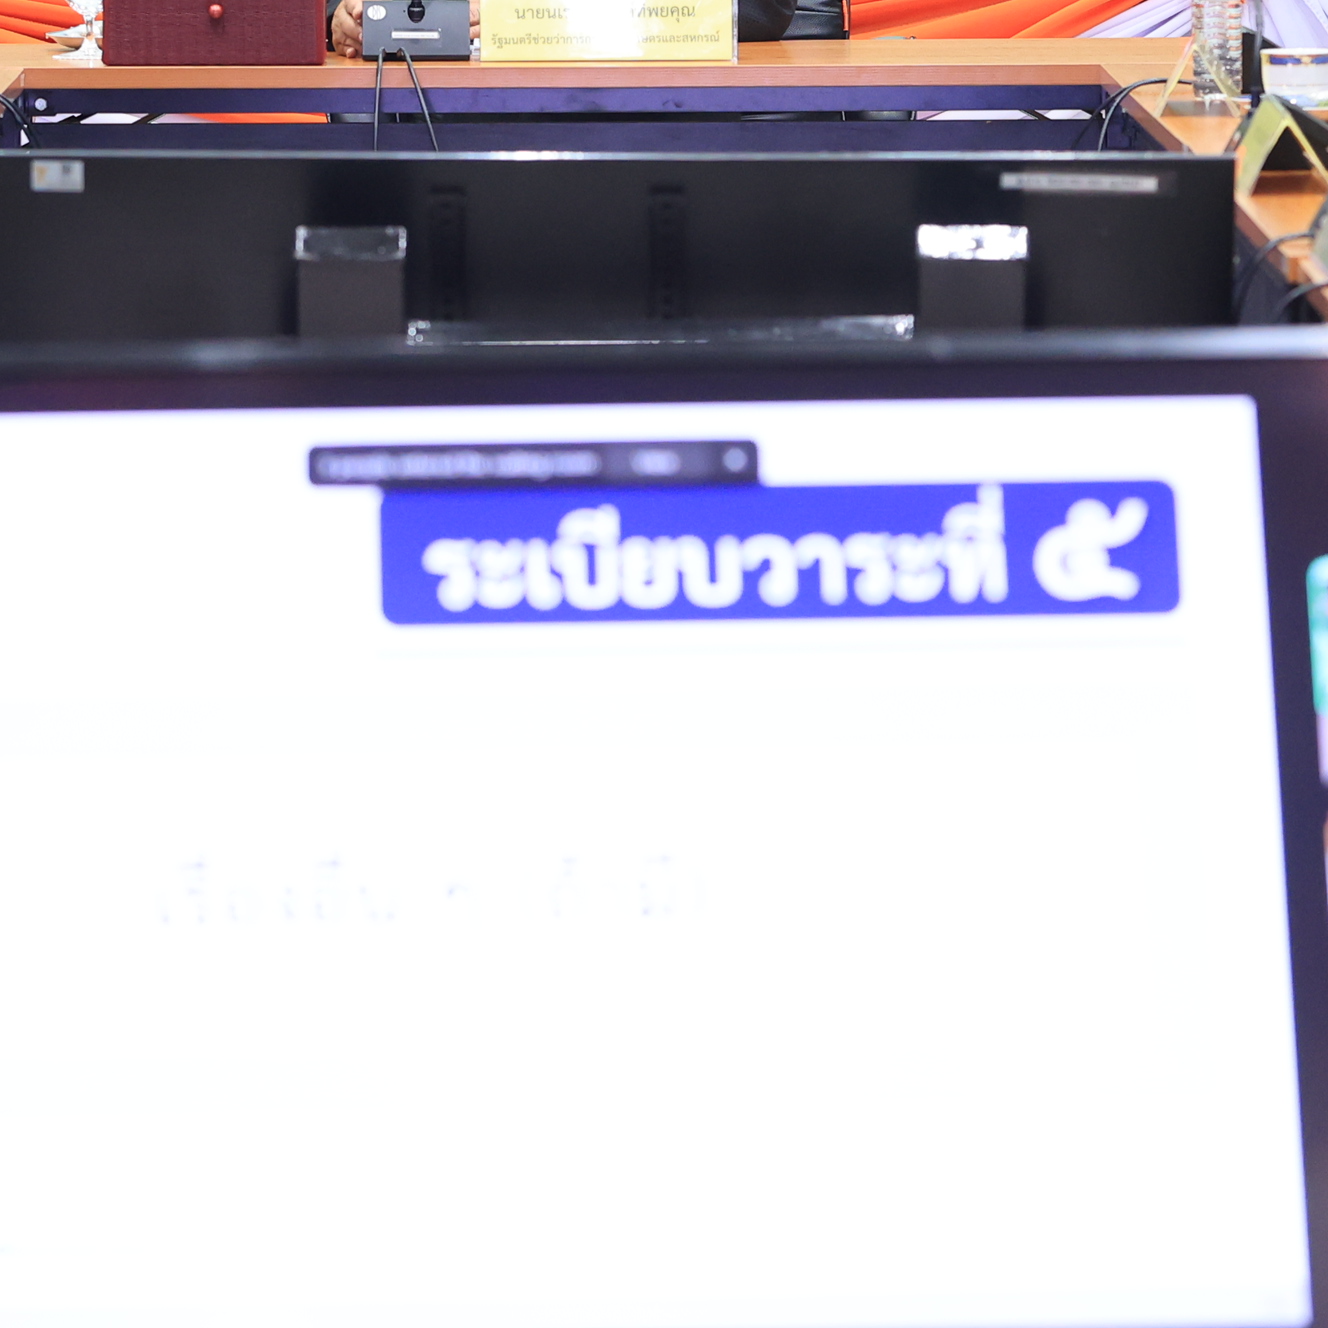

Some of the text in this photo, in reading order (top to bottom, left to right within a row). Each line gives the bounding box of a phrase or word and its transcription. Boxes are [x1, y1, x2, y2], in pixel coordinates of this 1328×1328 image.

[420, 481, 1149, 614] ระเบียบวาระที่ ๕
